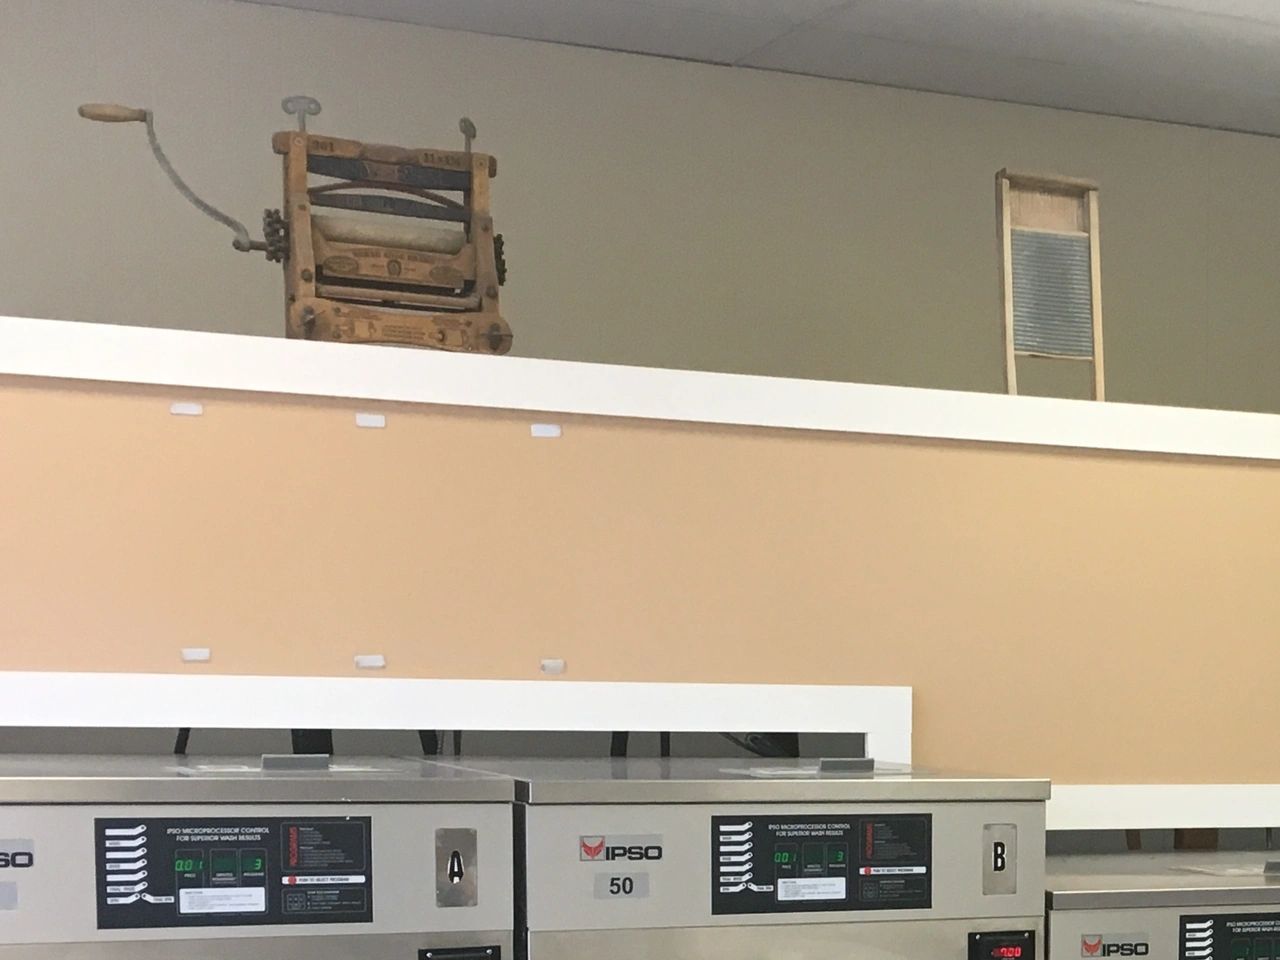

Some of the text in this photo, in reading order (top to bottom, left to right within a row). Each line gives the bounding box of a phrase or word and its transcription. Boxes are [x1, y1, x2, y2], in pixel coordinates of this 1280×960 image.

[605, 846, 663, 861] IPSO
[993, 842, 1006, 872] B
[448, 850, 464, 884] A
[609, 877, 634, 895] 50
[1102, 943, 1149, 957] IPSO
